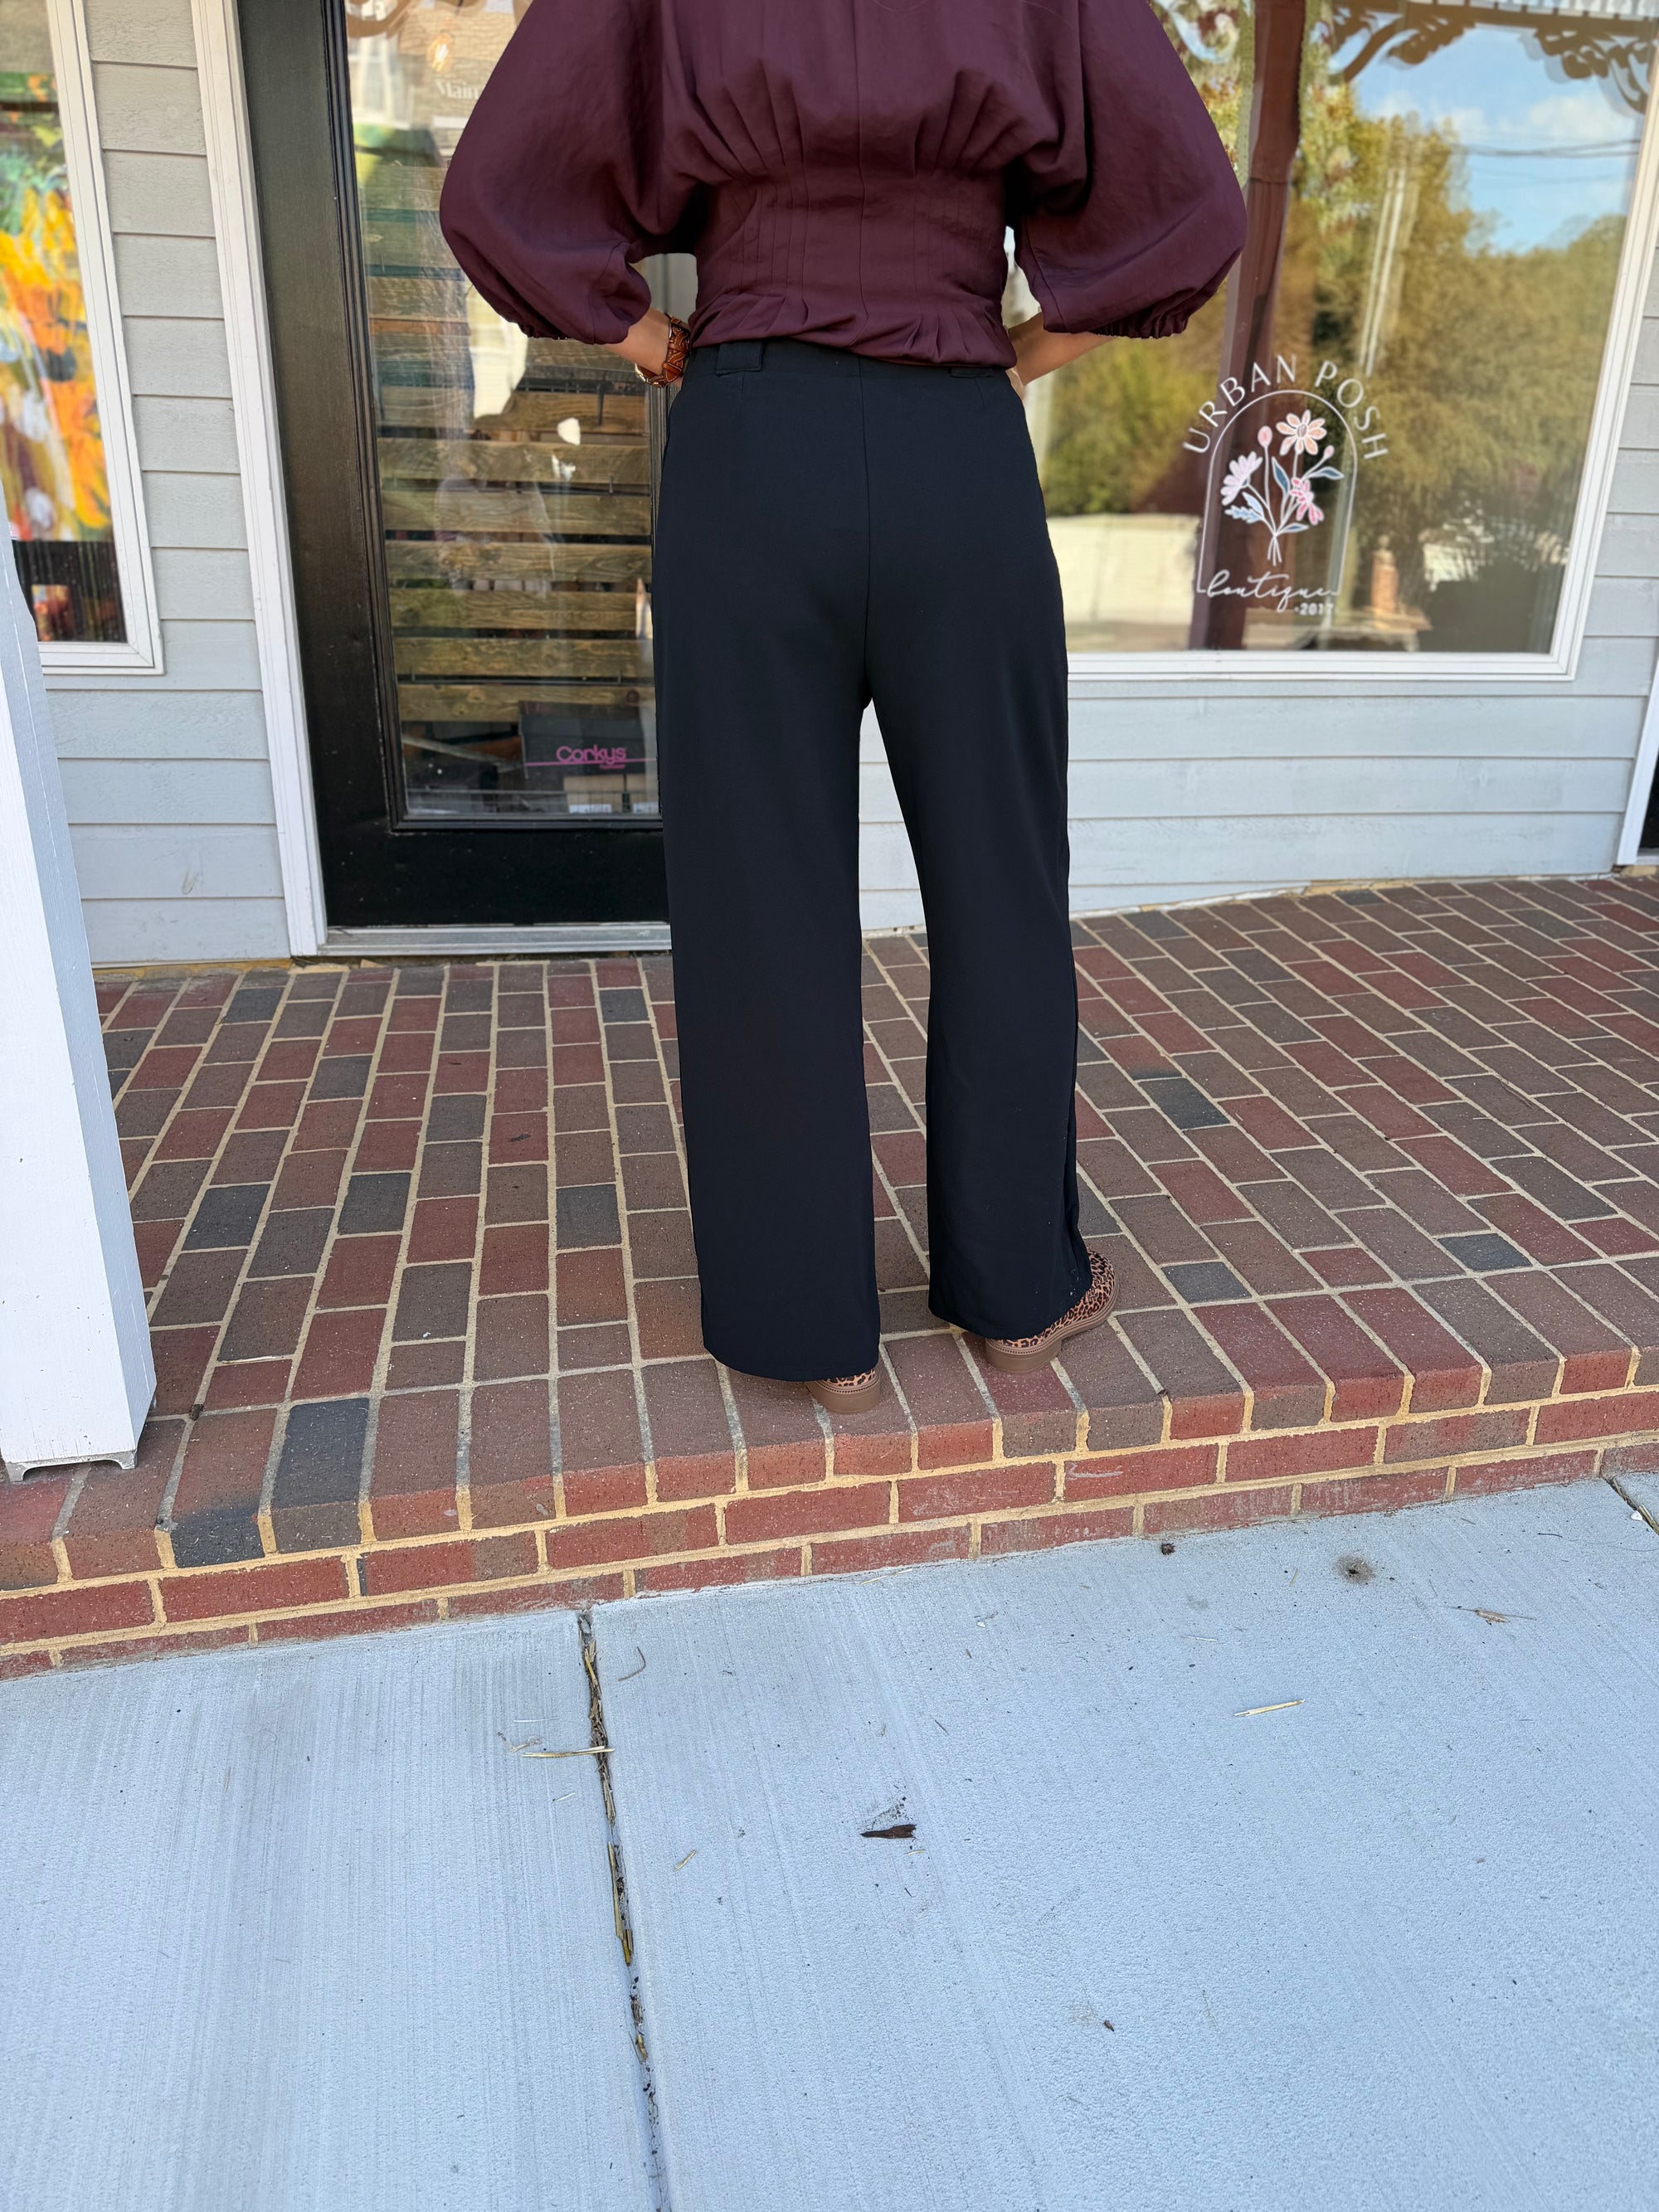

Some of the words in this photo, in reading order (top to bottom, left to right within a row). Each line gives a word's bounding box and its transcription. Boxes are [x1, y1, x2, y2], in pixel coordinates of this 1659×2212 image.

[435, 80, 479, 100] Main
[1182, 354, 1297, 454] URBAN
[1315, 360, 1389, 459] POSH
[1207, 569, 1331, 613] boutique
[556, 744, 626, 765] Corkys
